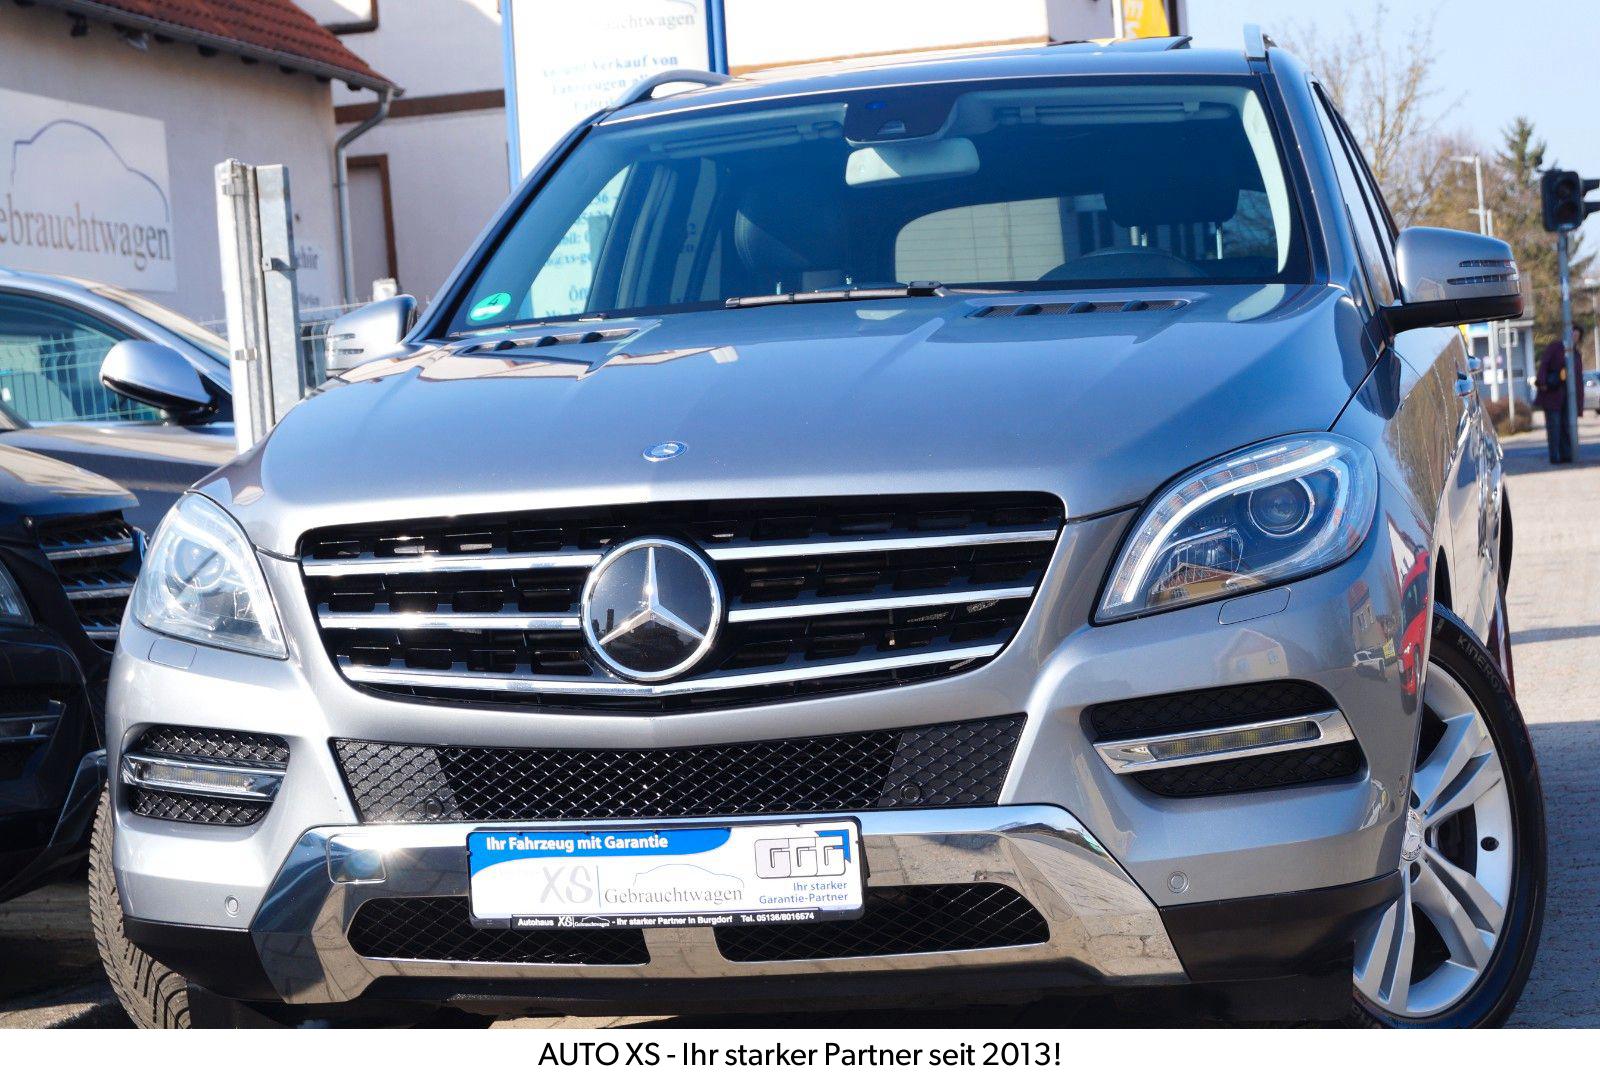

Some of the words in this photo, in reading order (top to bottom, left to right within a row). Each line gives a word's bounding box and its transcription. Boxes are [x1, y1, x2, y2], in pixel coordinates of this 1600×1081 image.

[652, 55, 679, 66] von
[486, 836, 506, 851] Ihr
[509, 836, 575, 853] Fahrzeug
[577, 835, 602, 850] mit
[604, 834, 669, 849] Garantie
[540, 865, 594, 904] XS
[793, 882, 808, 891] Ihr
[810, 880, 848, 891] starker
[604, 886, 742, 905] Gebrauchtwagen
[759, 892, 848, 905] Garantie-Partner
[517, 917, 554, 927] Autohaus
[558, 915, 573, 927] XS
[616, 917, 628, 926] Ihr
[628, 916, 656, 926] starker
[658, 916, 686, 926] Partner
[688, 916, 696, 925] in
[698, 915, 733, 926] Burgdorf
[740, 914, 755, 924] Tel.
